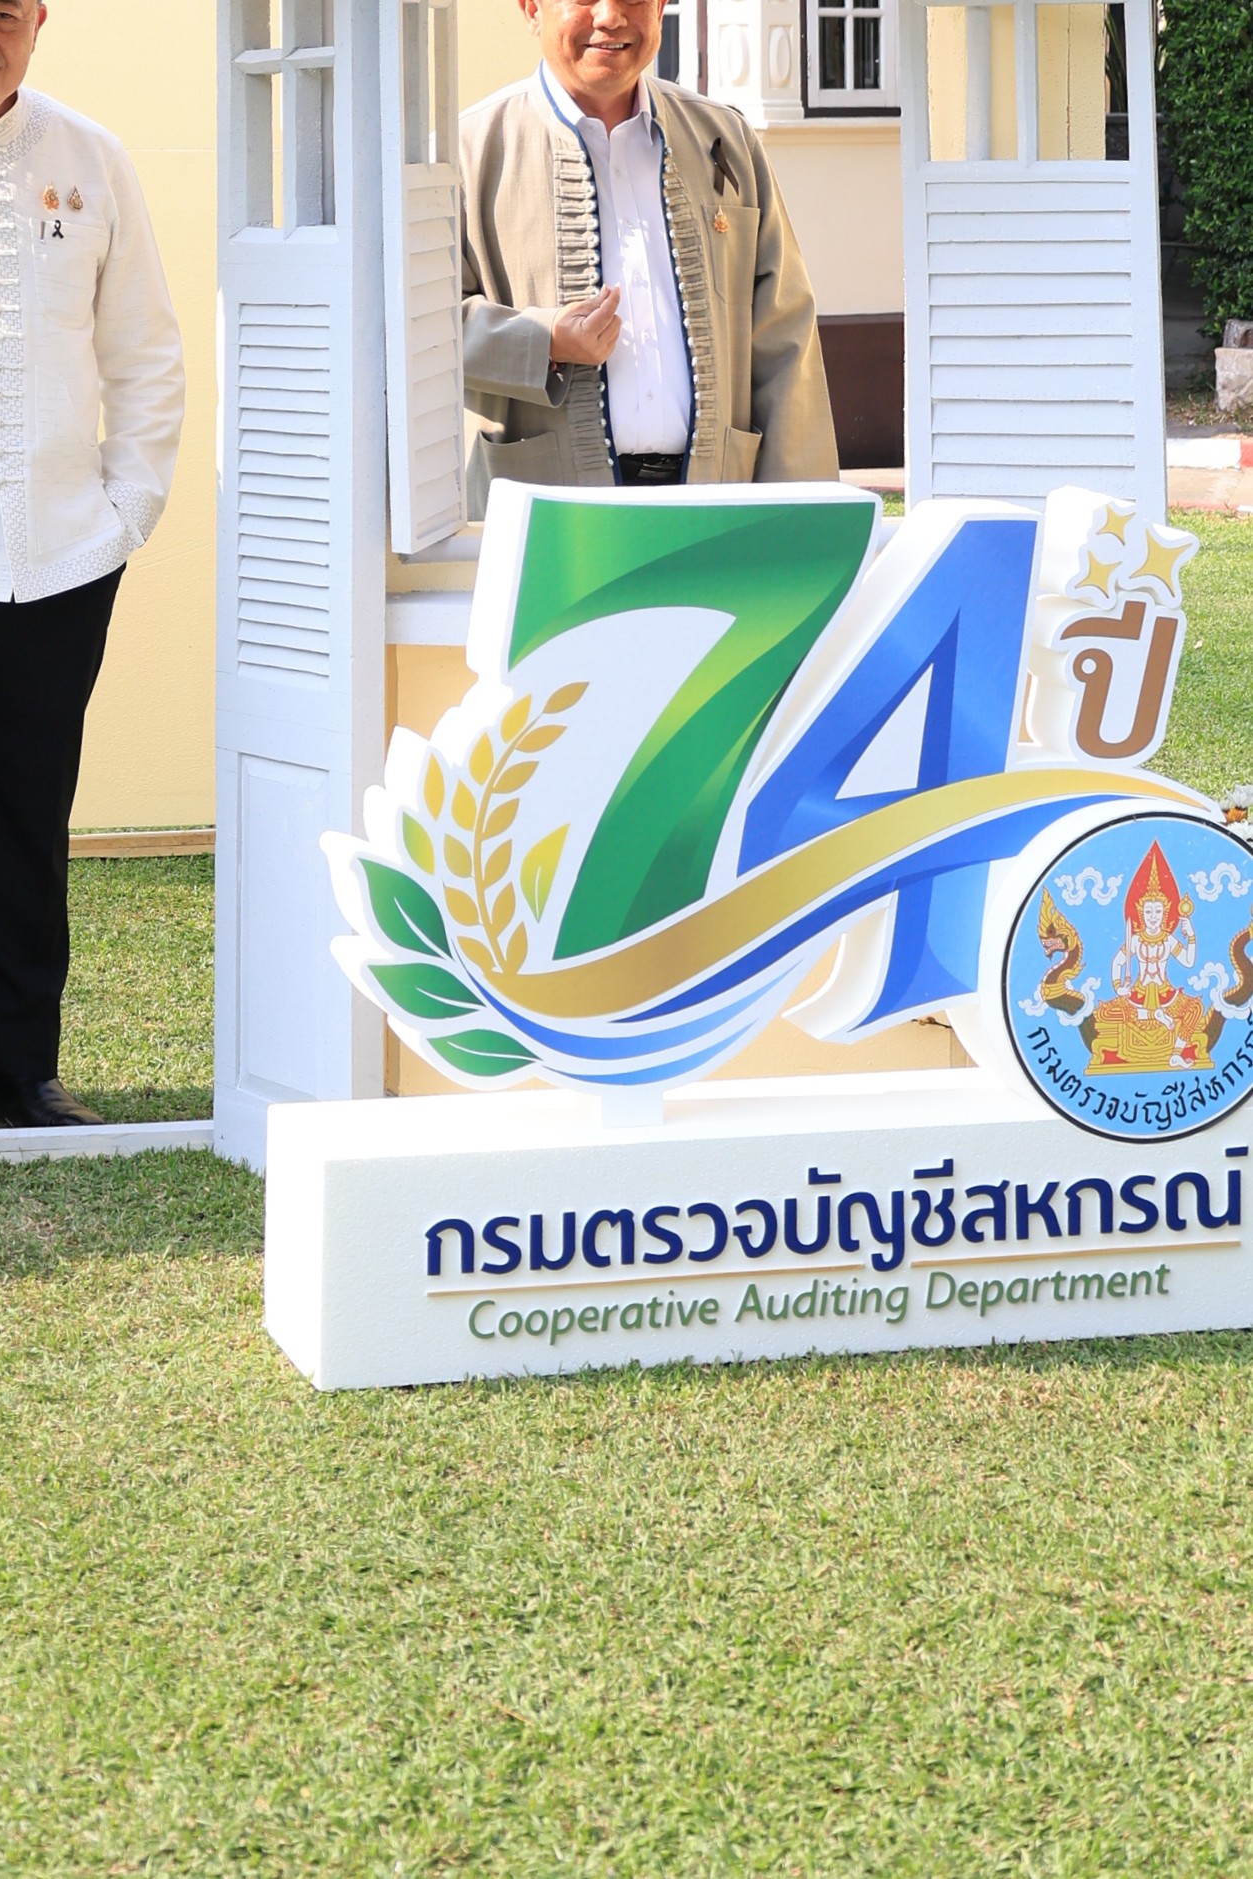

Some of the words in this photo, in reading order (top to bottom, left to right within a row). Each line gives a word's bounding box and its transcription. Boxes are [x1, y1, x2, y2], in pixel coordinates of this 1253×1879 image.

[1060, 600, 1180, 760] ปี
[425, 1146, 1249, 1275] กรมตรวจบัญชีสหกรณ์
[467, 1289, 720, 1346] Cooperative
[735, 1277, 910, 1323] Auditing
[925, 1263, 1171, 1318] Department
